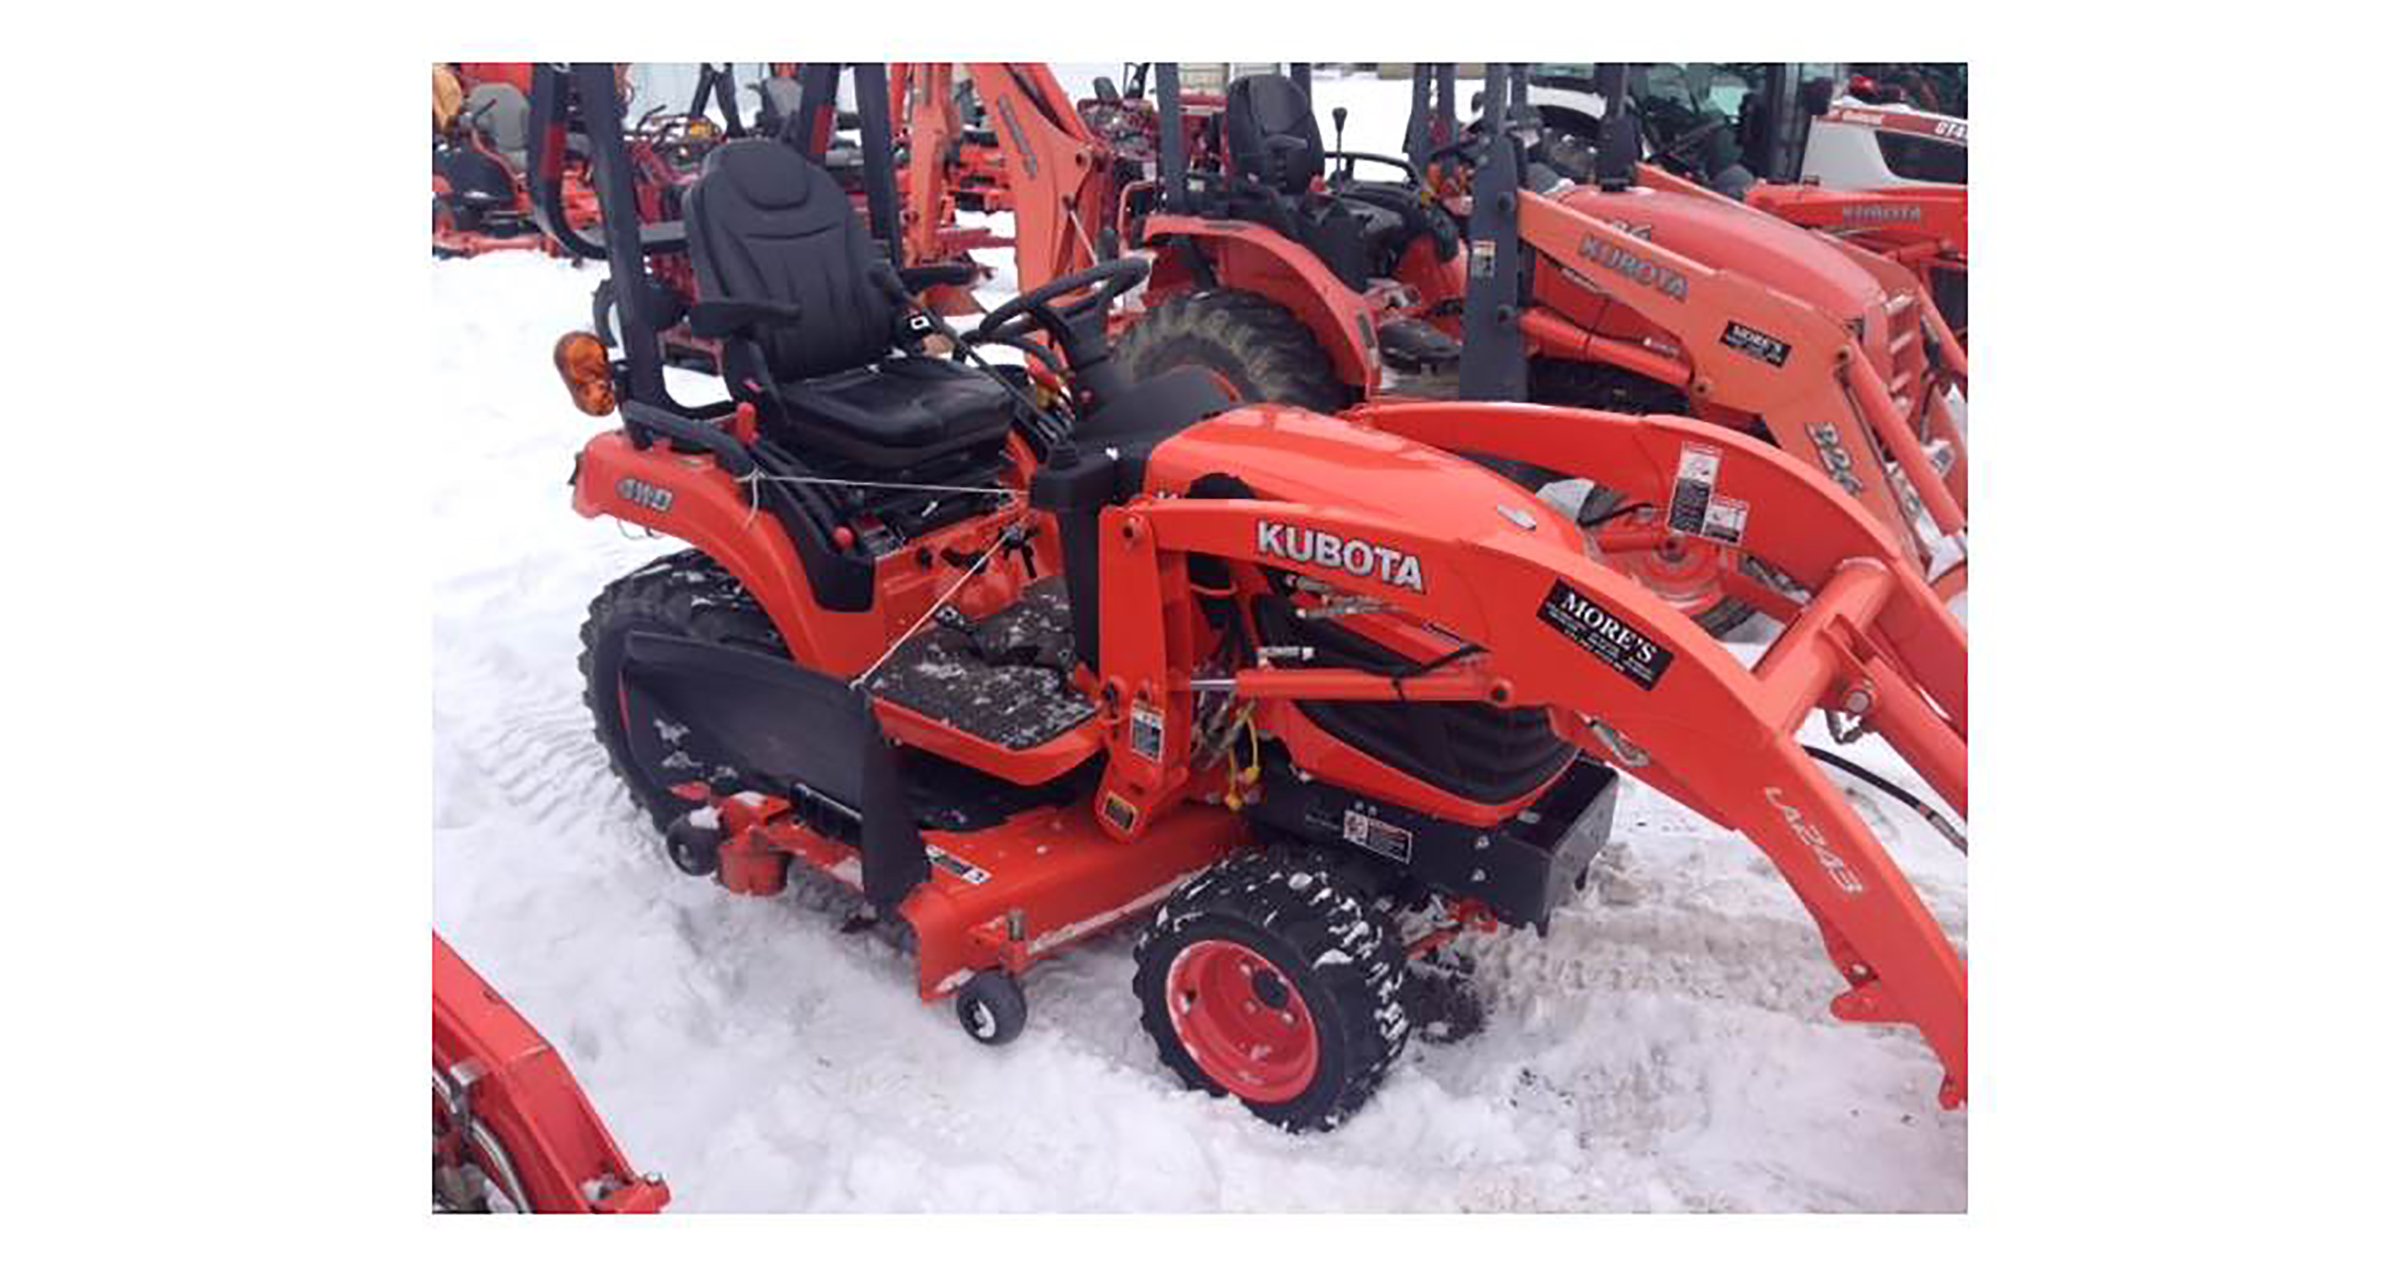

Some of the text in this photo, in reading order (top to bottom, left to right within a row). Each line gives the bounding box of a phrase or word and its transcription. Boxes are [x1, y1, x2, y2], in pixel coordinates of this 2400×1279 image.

[1934, 120, 1968, 139] GT4
[1580, 231, 1689, 303] KUBOTA
[1257, 520, 1424, 593] KUBOTA
[1561, 592, 1658, 664] MORE'S
[1764, 786, 1863, 892] LA243
